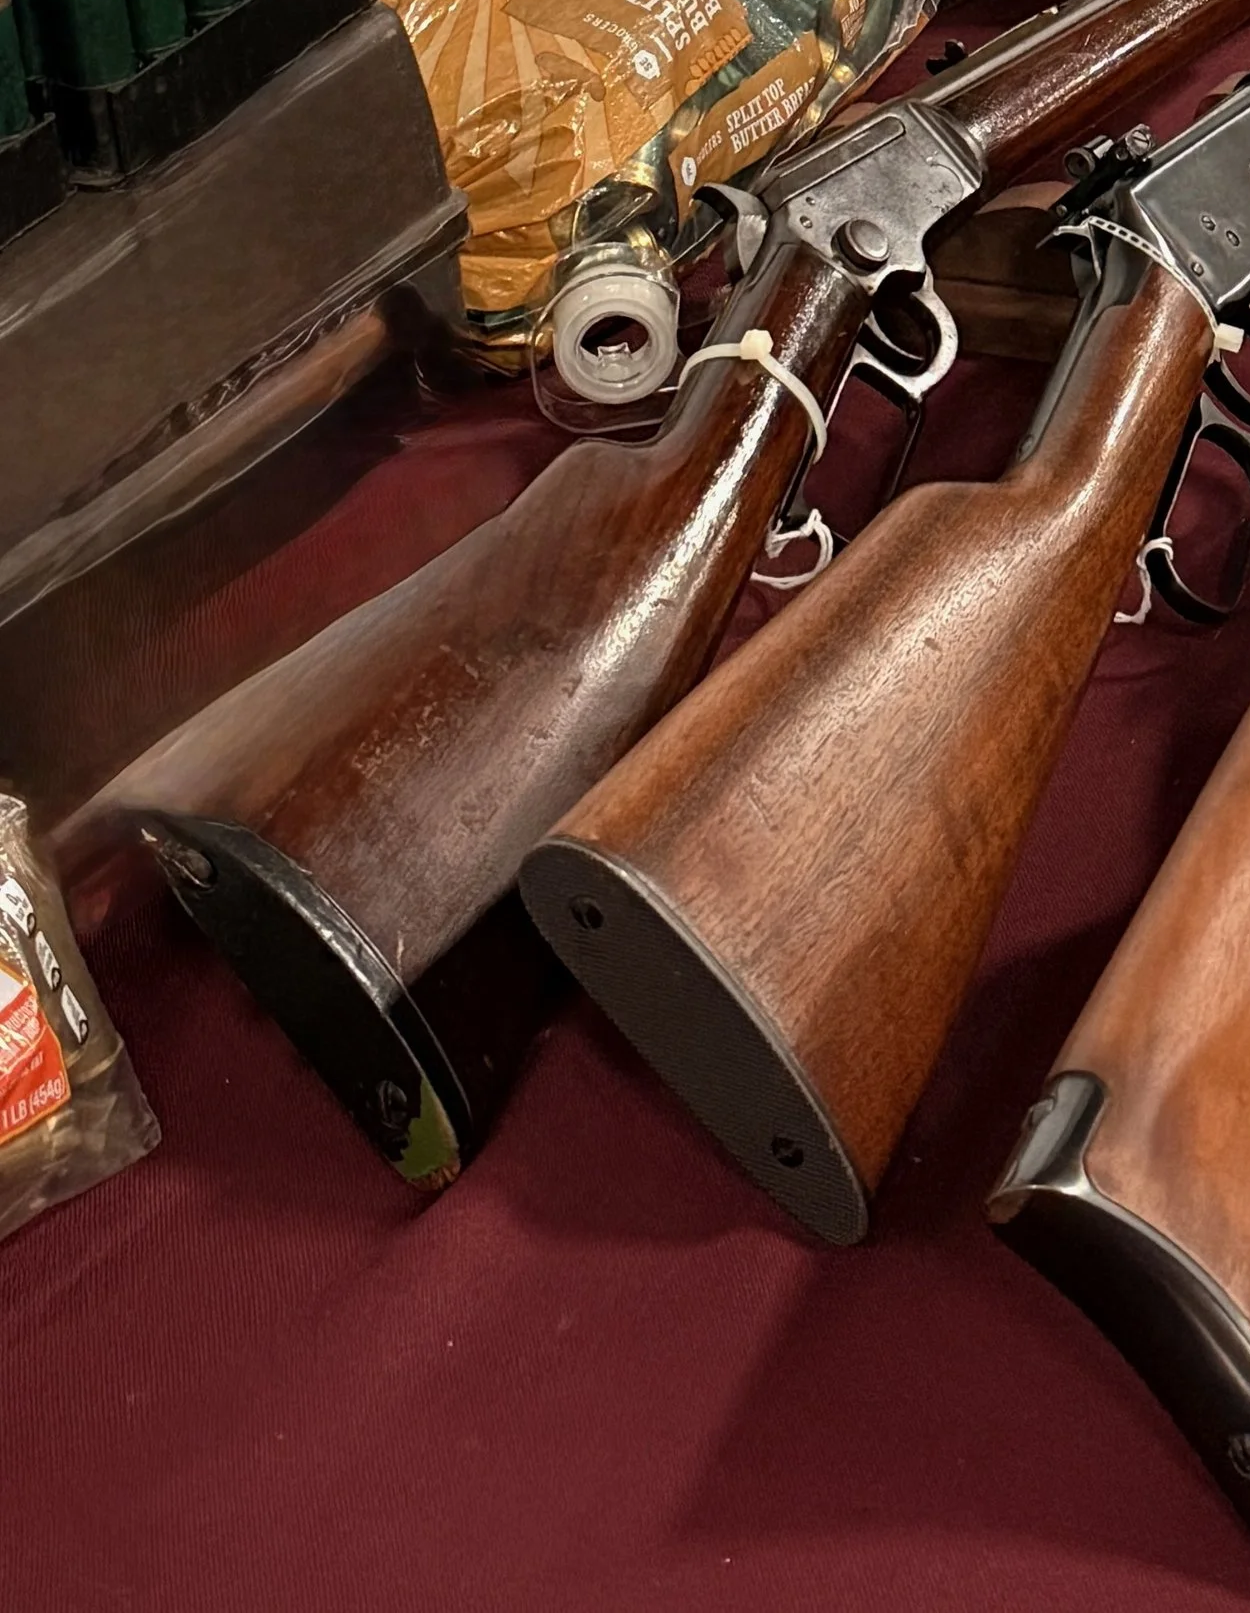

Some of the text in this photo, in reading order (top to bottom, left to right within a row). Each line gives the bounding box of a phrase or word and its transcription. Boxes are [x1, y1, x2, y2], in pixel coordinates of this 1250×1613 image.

[726, 77, 786, 134] SPLIT TOP
[729, 107, 786, 155] BUTTER
[28, 1071, 66, 1116] (454g)
